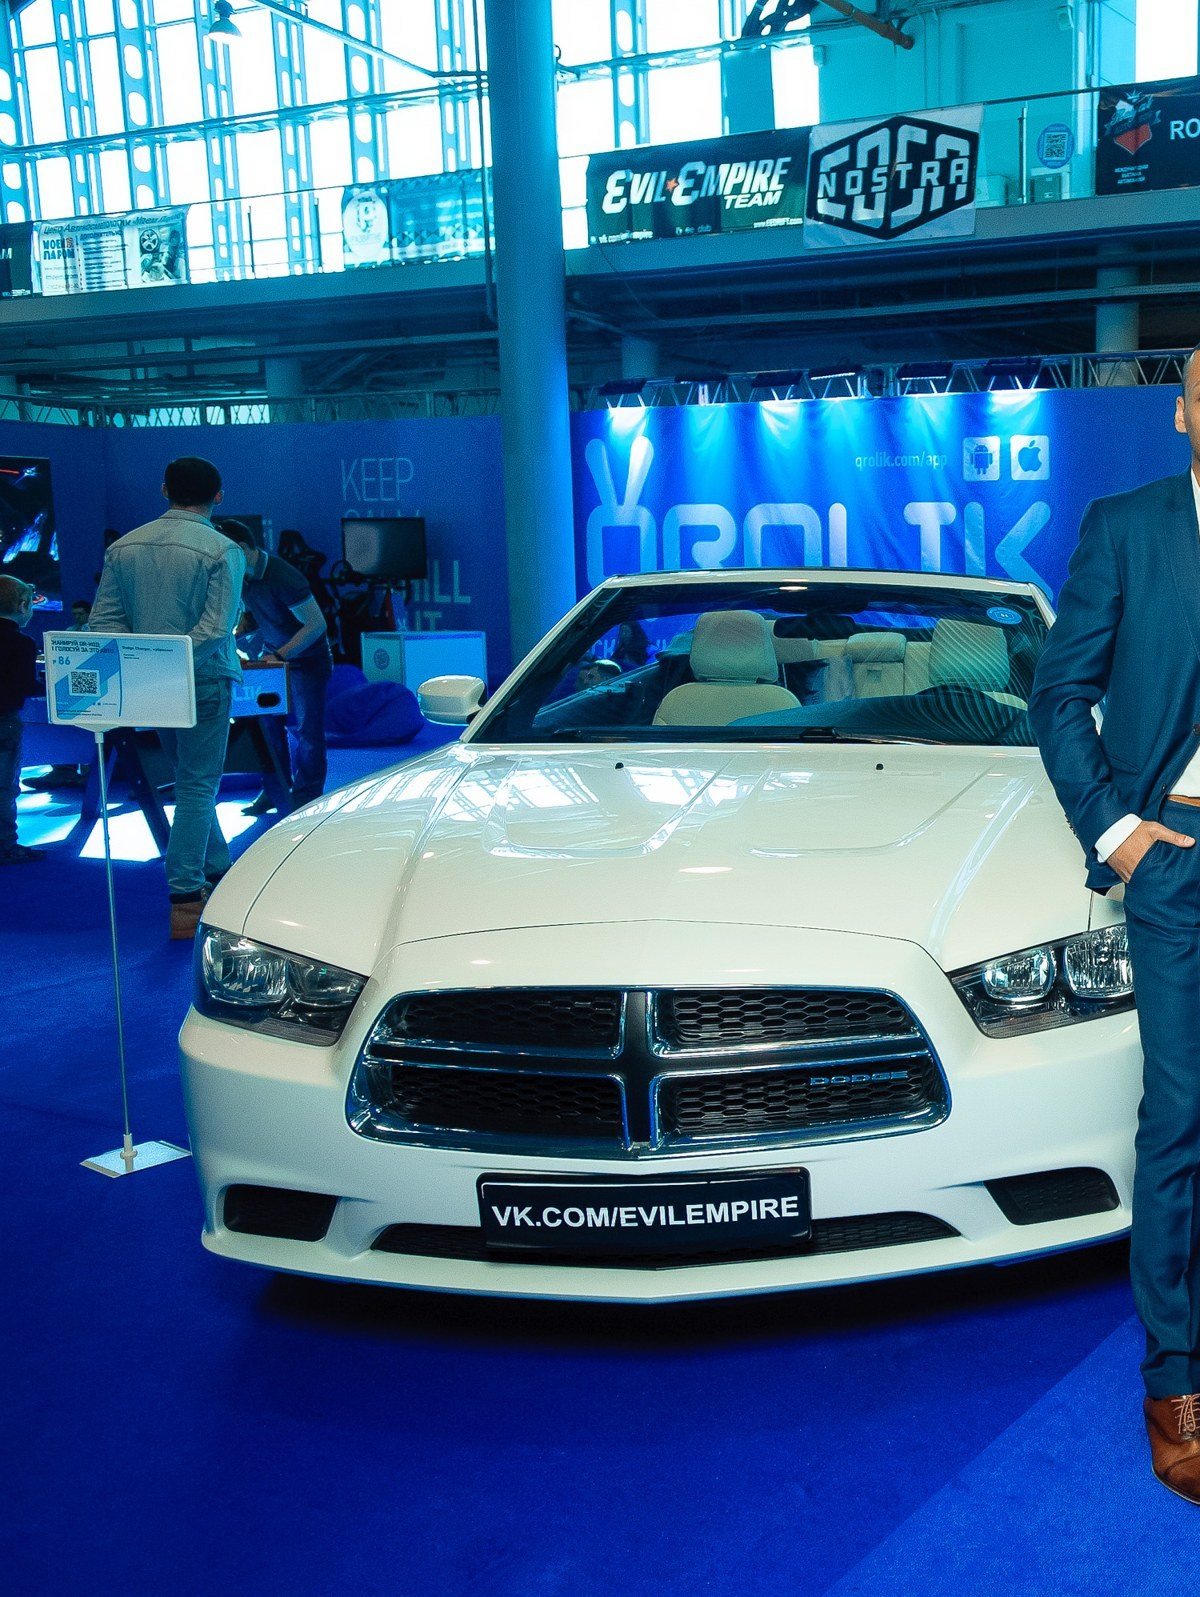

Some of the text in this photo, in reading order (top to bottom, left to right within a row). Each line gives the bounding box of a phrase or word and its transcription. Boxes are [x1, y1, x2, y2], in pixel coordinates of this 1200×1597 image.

[817, 157, 970, 199] NOSTRA
[724, 190, 782, 209] TEAM
[855, 451, 948, 471] qrolik.com/app
[341, 457, 414, 501] KEEP
[58, 656, 71, 665] 86
[810, 1070, 908, 1086] DODGE
[492, 1196, 799, 1228] VK.COM/EVILEMPIRE
